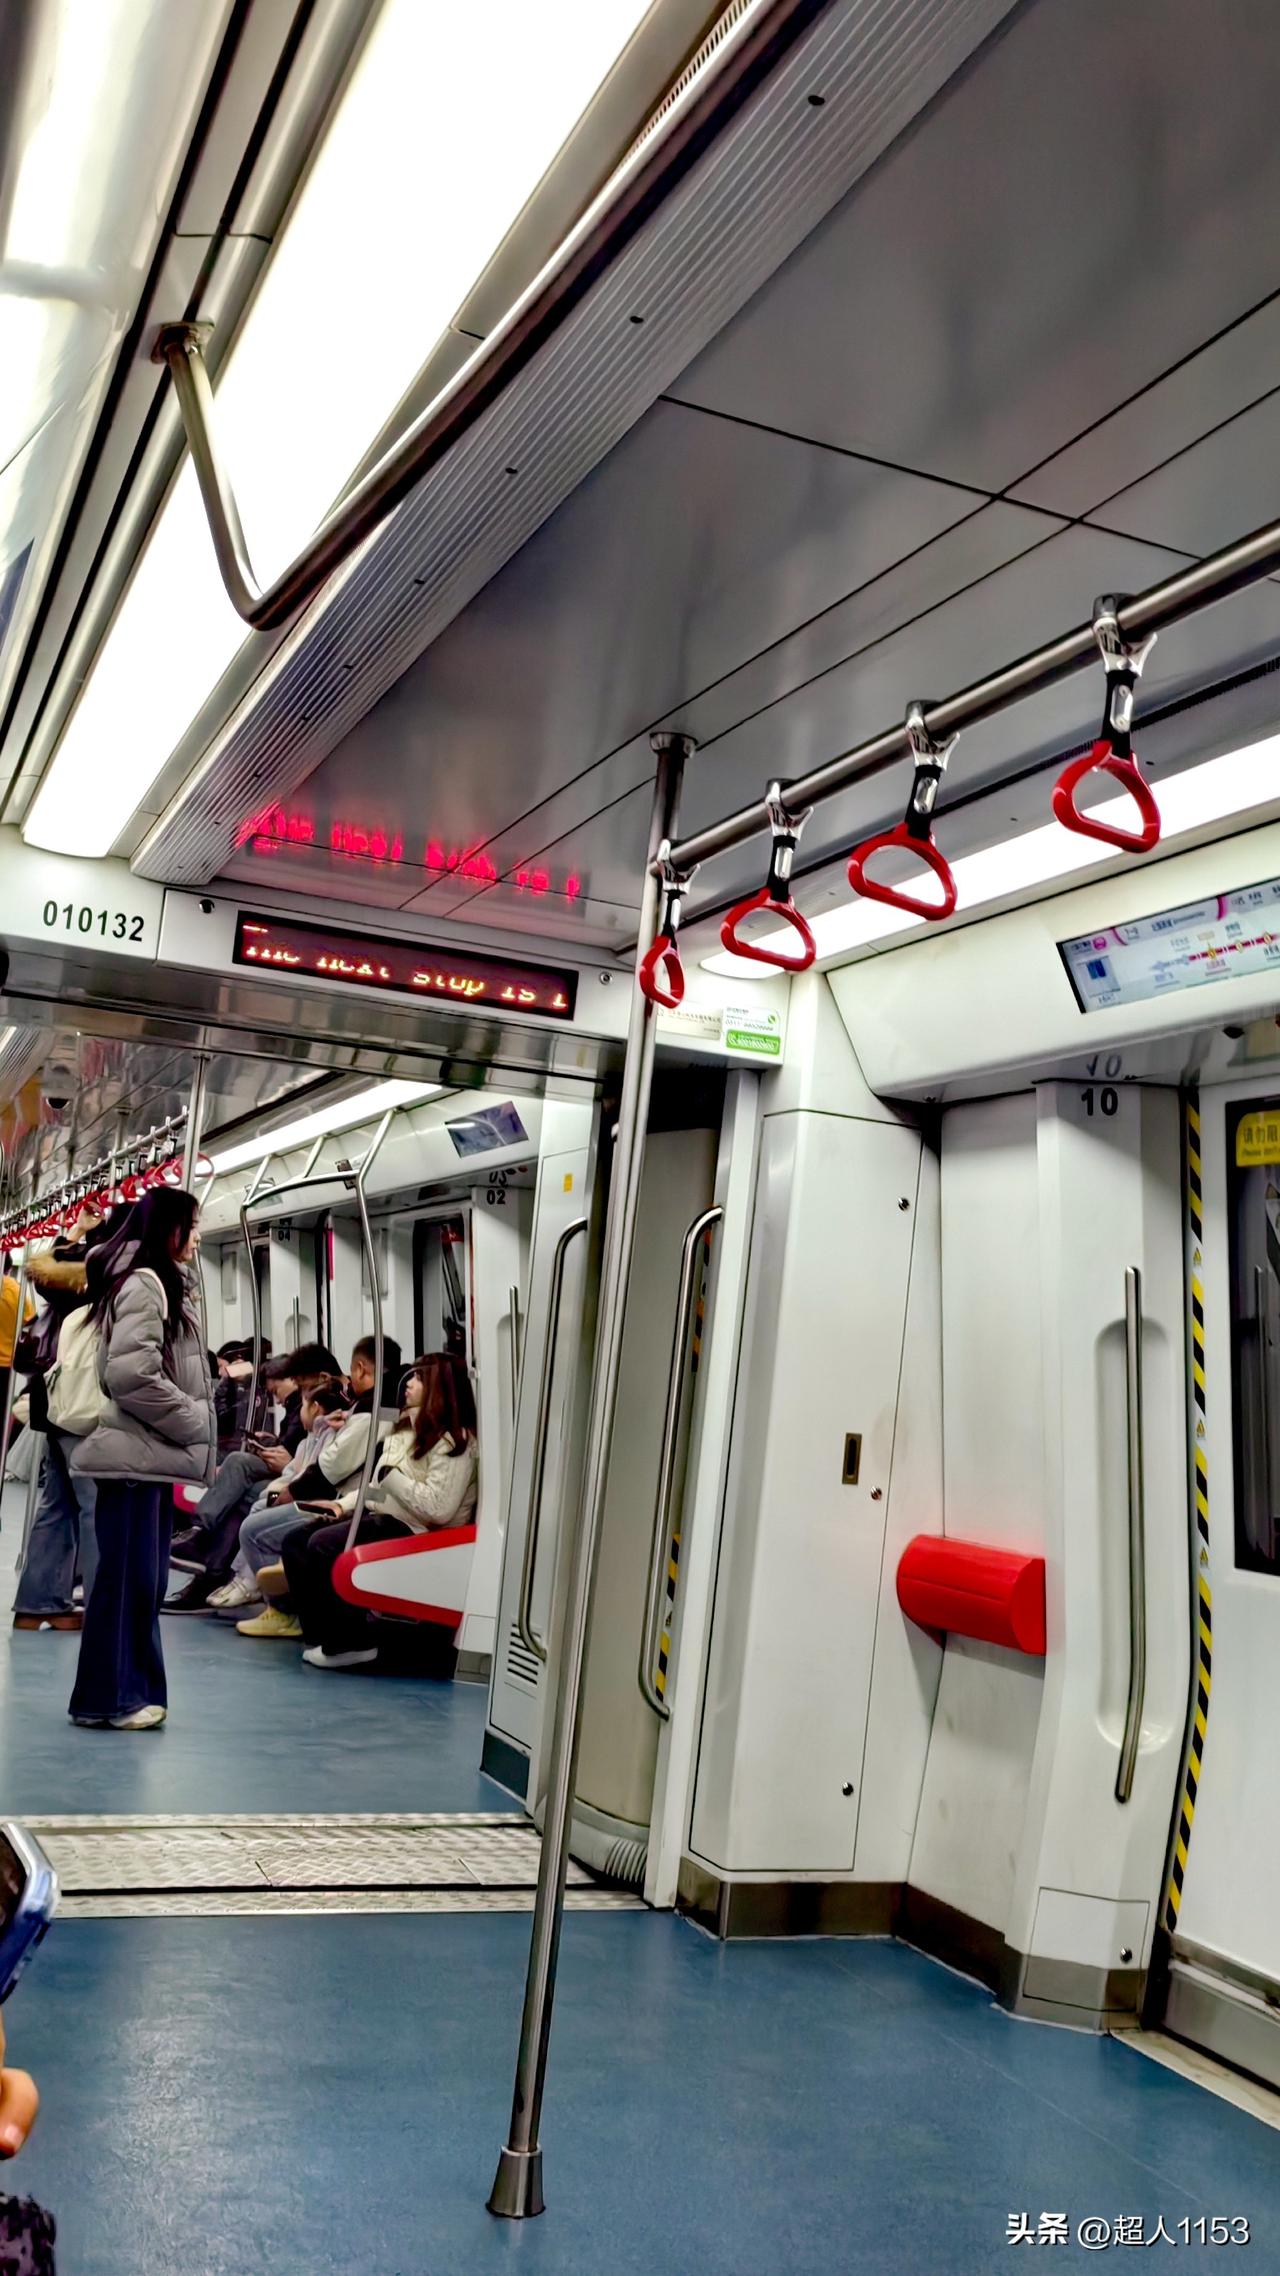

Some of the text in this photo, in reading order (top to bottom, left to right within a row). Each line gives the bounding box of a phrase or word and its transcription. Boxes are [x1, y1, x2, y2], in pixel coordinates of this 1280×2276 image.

[43, 900, 145, 942] 010132
[1081, 1087, 1118, 1116] 10
[486, 1189, 506, 1206] 02
[278, 1230, 291, 1242] 04
